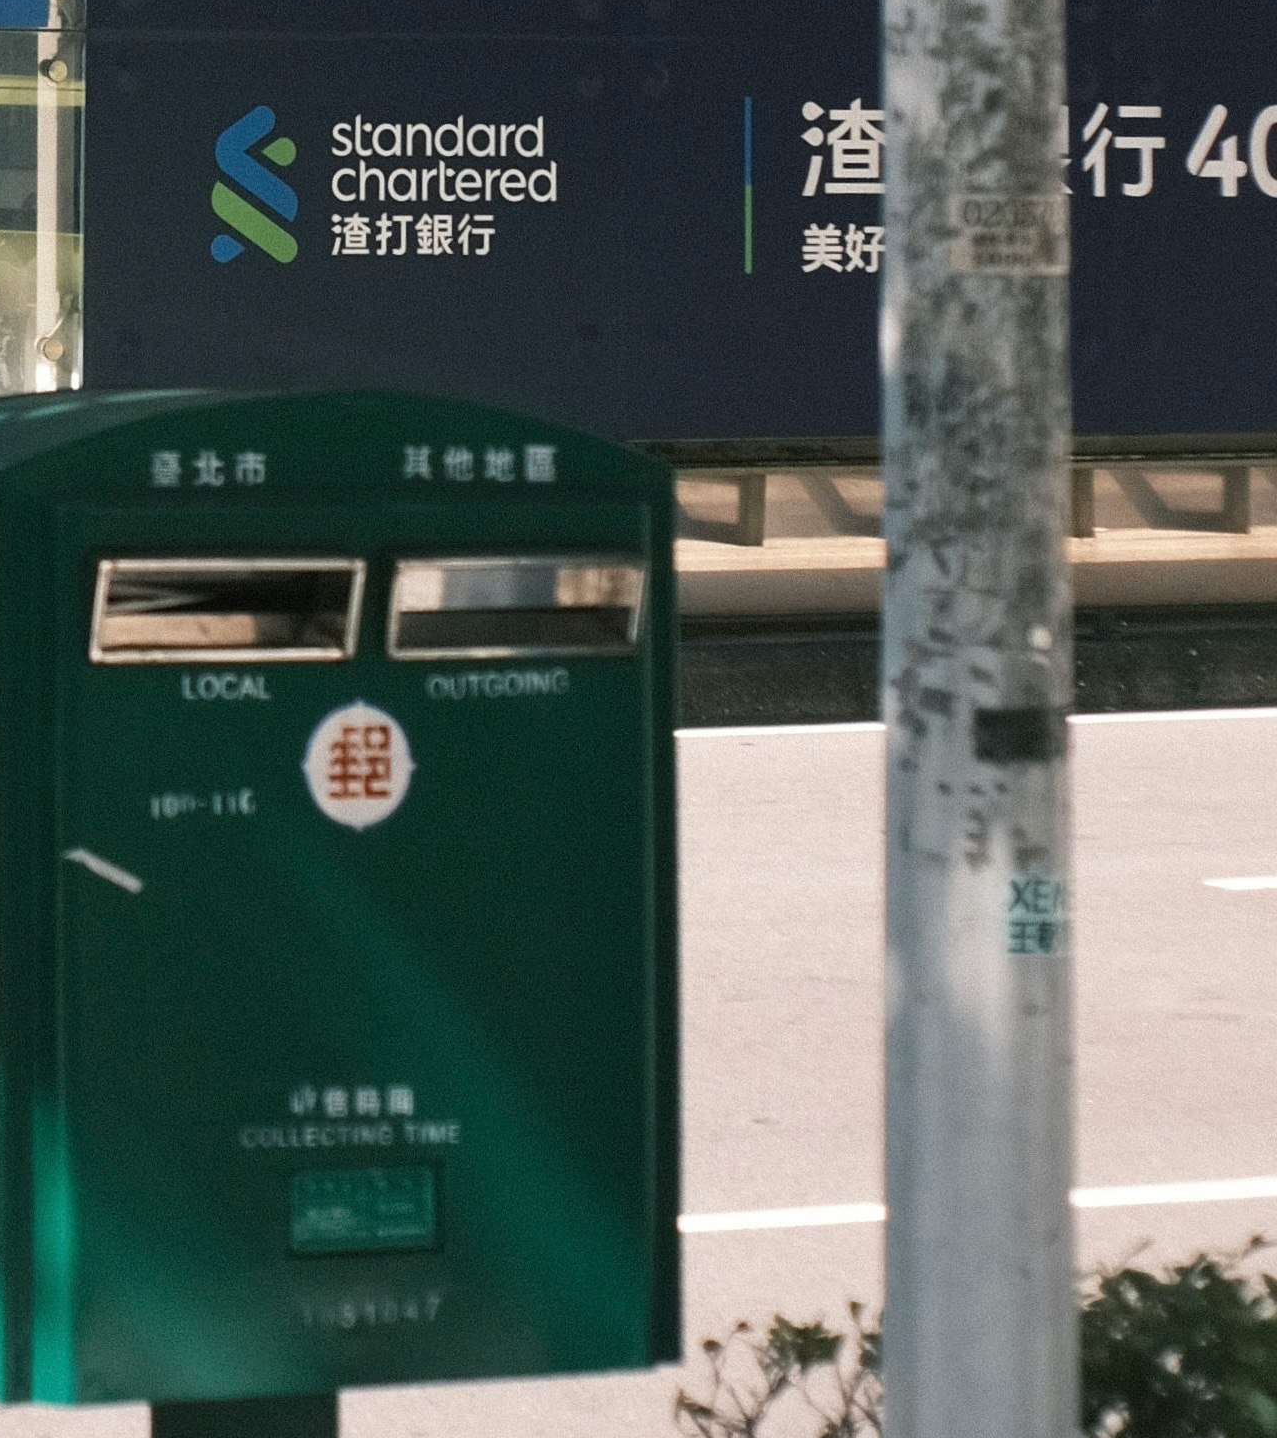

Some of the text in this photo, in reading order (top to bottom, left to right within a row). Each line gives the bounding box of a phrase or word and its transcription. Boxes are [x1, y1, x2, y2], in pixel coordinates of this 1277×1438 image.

[331, 114, 545, 160] standard
[800, 97, 1167, 198] 渣行
[331, 158, 558, 205] chartered
[331, 213, 496, 258] 渣打銀行
[149, 449, 267, 488] 臺北市
[402, 444, 558, 484] 其他地區
[181, 673, 272, 702] LOCAL
[425, 667, 570, 701] OUTGOING
[403, 1120, 462, 1145] TIME
